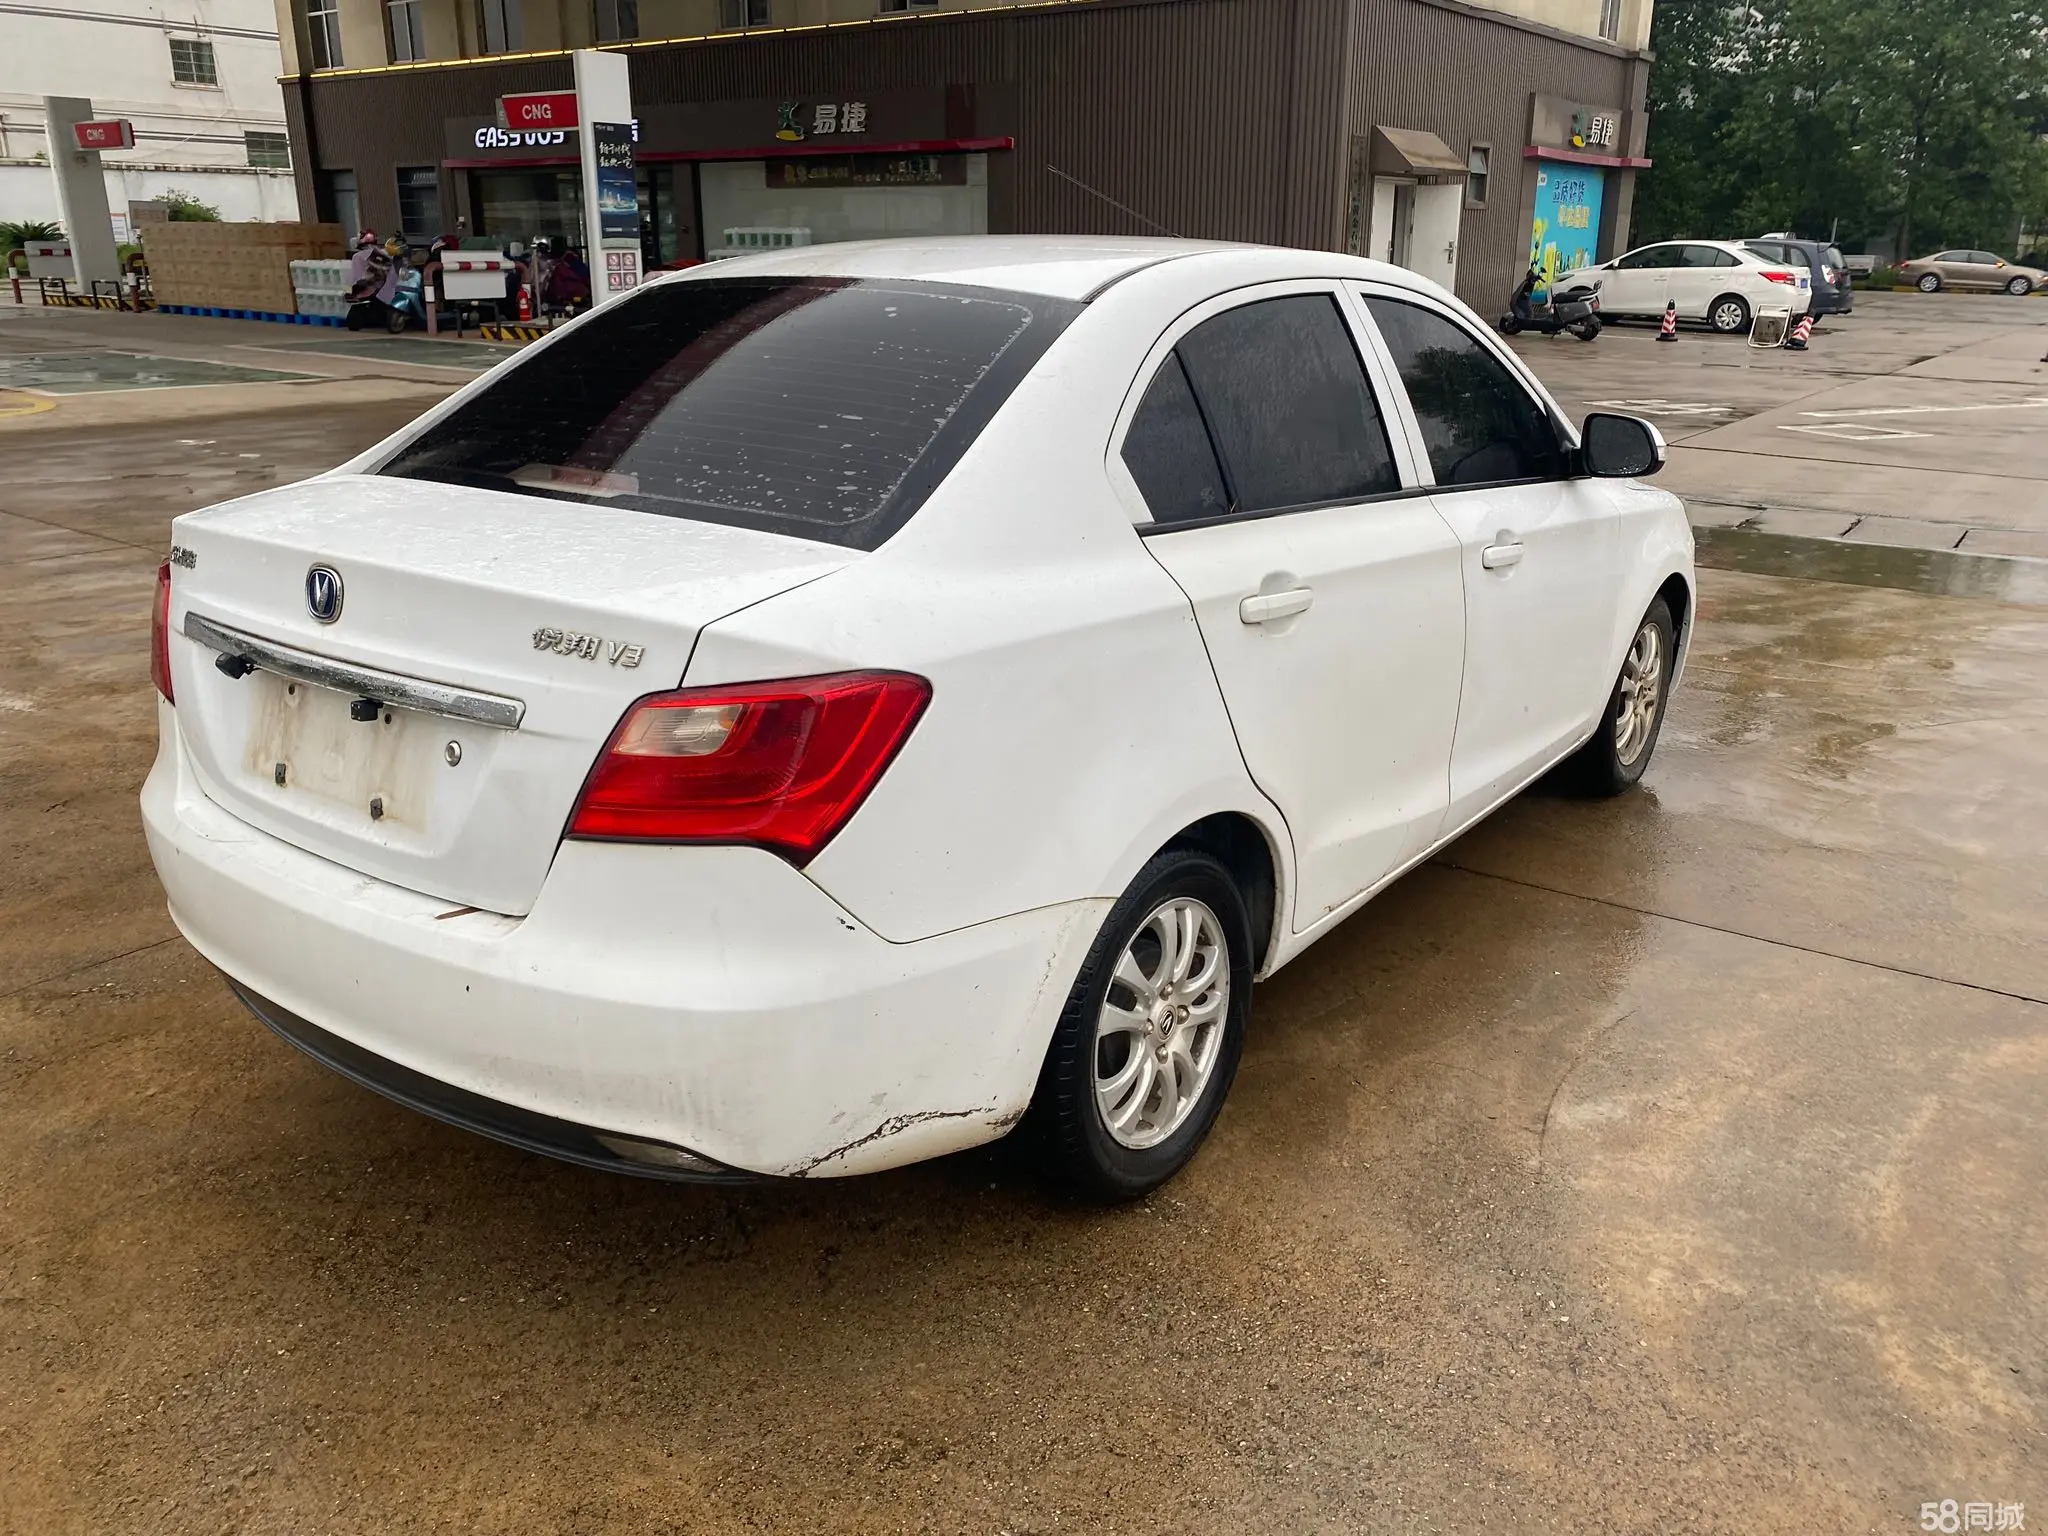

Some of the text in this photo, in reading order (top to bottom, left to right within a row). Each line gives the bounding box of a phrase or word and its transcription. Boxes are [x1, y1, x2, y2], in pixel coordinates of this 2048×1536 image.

[521, 103, 552, 120] CNG
[813, 102, 866, 133] 易捷
[86, 128, 105, 141] CNG
[1590, 116, 1613, 146] 易捷
[531, 628, 645, 668] 悦翔 V3
